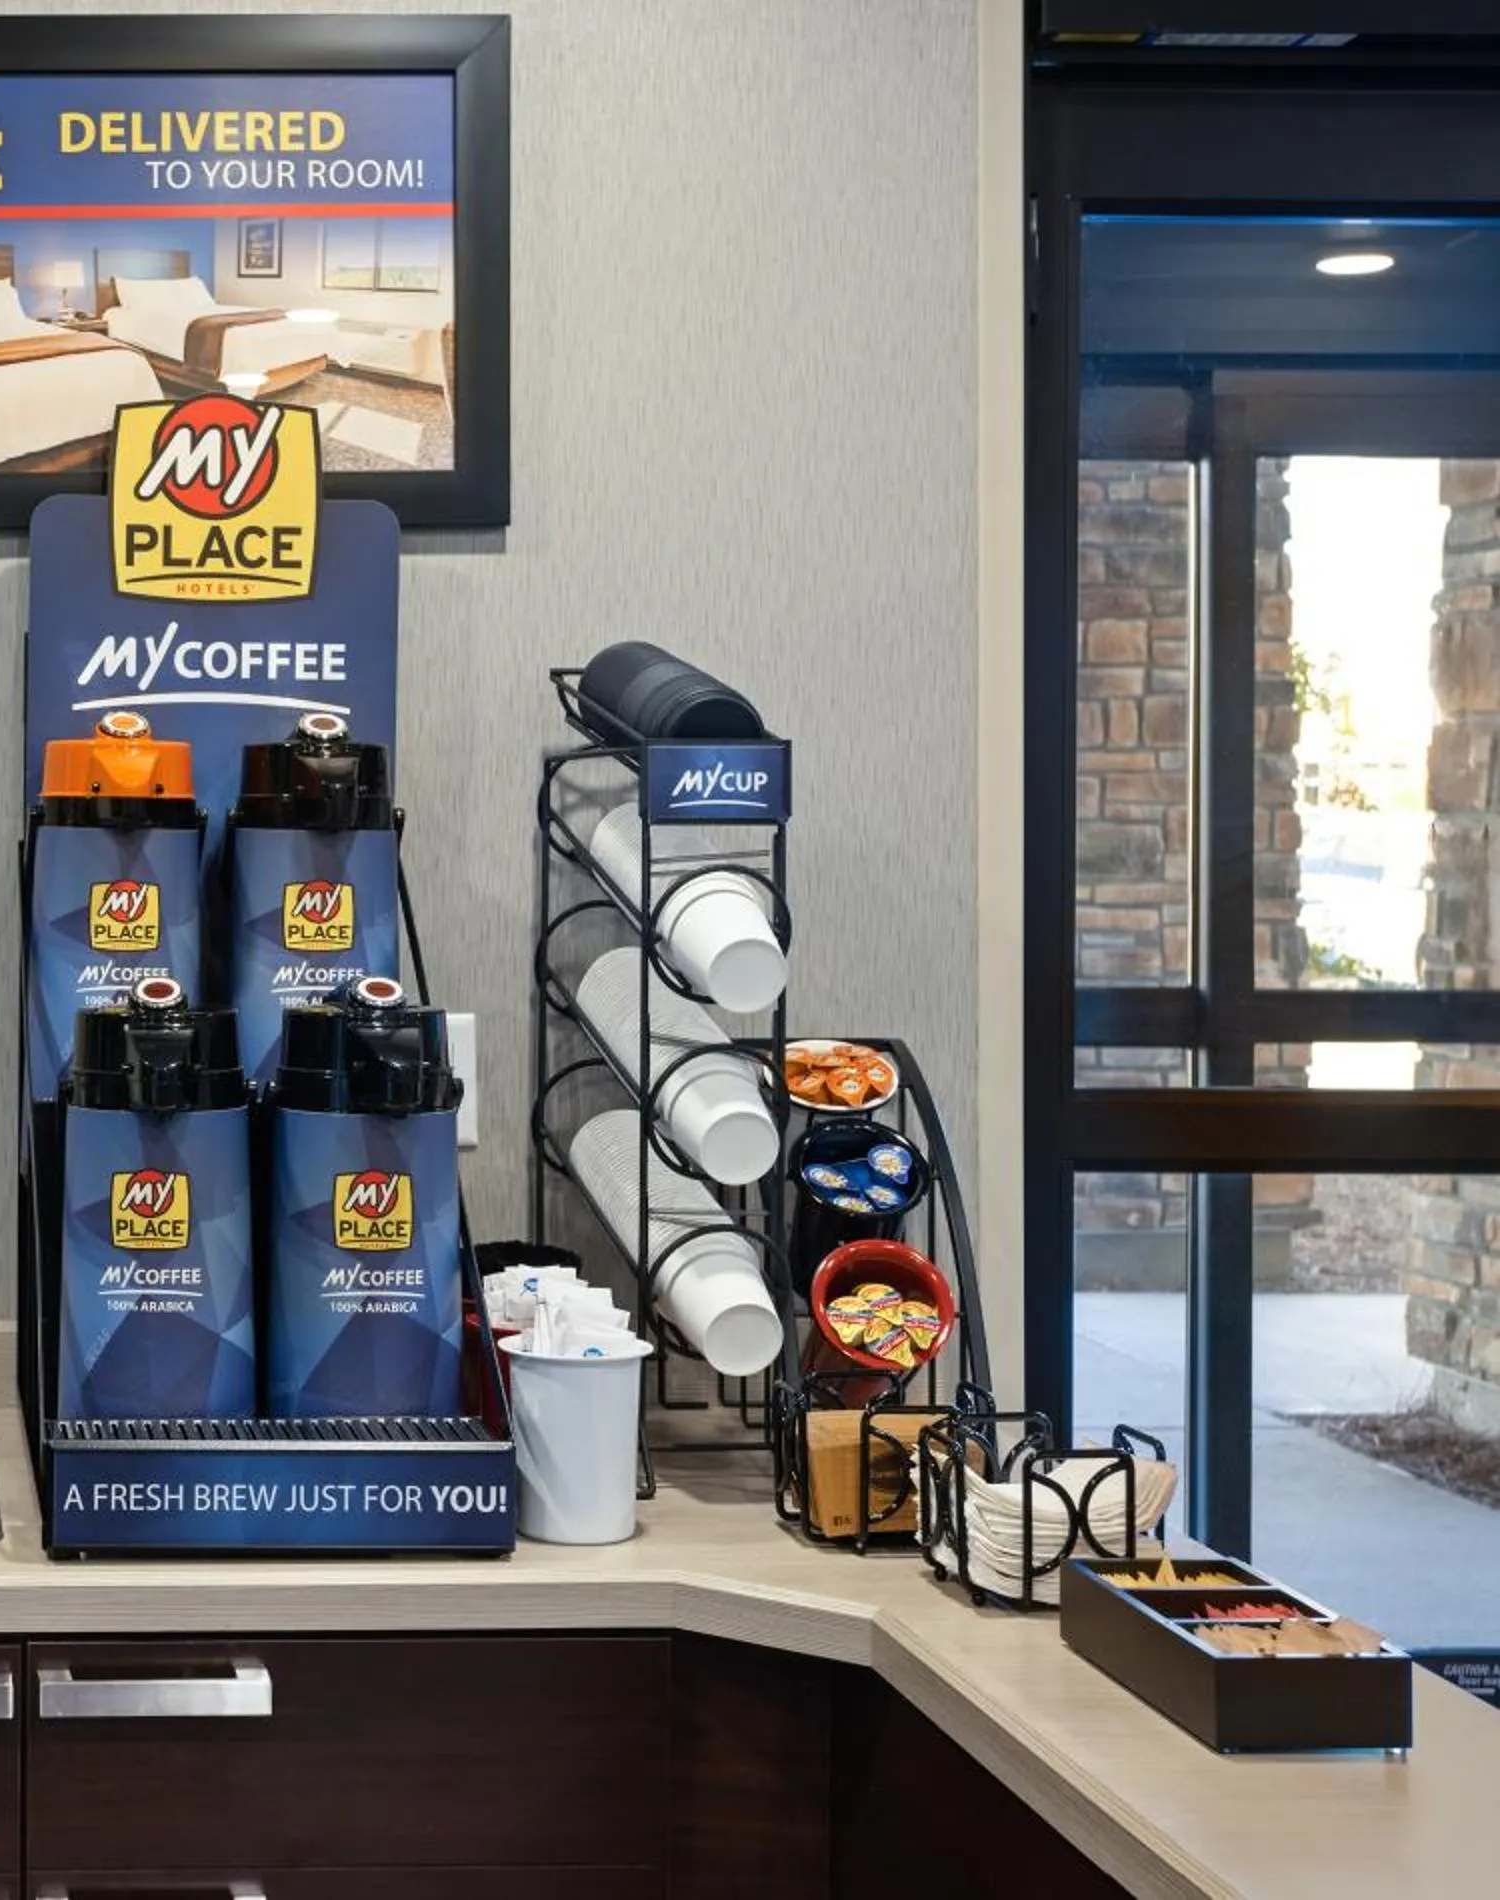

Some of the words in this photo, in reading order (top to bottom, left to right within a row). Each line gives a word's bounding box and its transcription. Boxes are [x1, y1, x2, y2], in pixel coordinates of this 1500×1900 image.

[59, 111, 346, 154] DELIVERED
[145, 160, 189, 190] TO
[201, 160, 296, 189] YOUR
[308, 159, 424, 189] ROOM!
[135, 406, 283, 506] MY
[124, 523, 303, 569] PLACE
[176, 583, 251, 595] HOTELS
[93, 925, 156, 940] PLACE
[287, 925, 351, 940] PLACE
[115, 1219, 185, 1237] PLACE
[339, 1220, 408, 1238] PLACE
[107, 1300, 138, 1312] 100%
[140, 1300, 195, 1312] ARABICA
[330, 1301, 363, 1313] 100%
[365, 1301, 419, 1313] ARABICA
[63, 1485, 84, 1511] A
[93, 1484, 183, 1512] FRESH
[193, 1484, 278, 1512] BREW
[285, 1485, 356, 1512] JUST
[364, 1486, 423, 1512] FOR
[431, 1486, 508, 1513] YOU!
